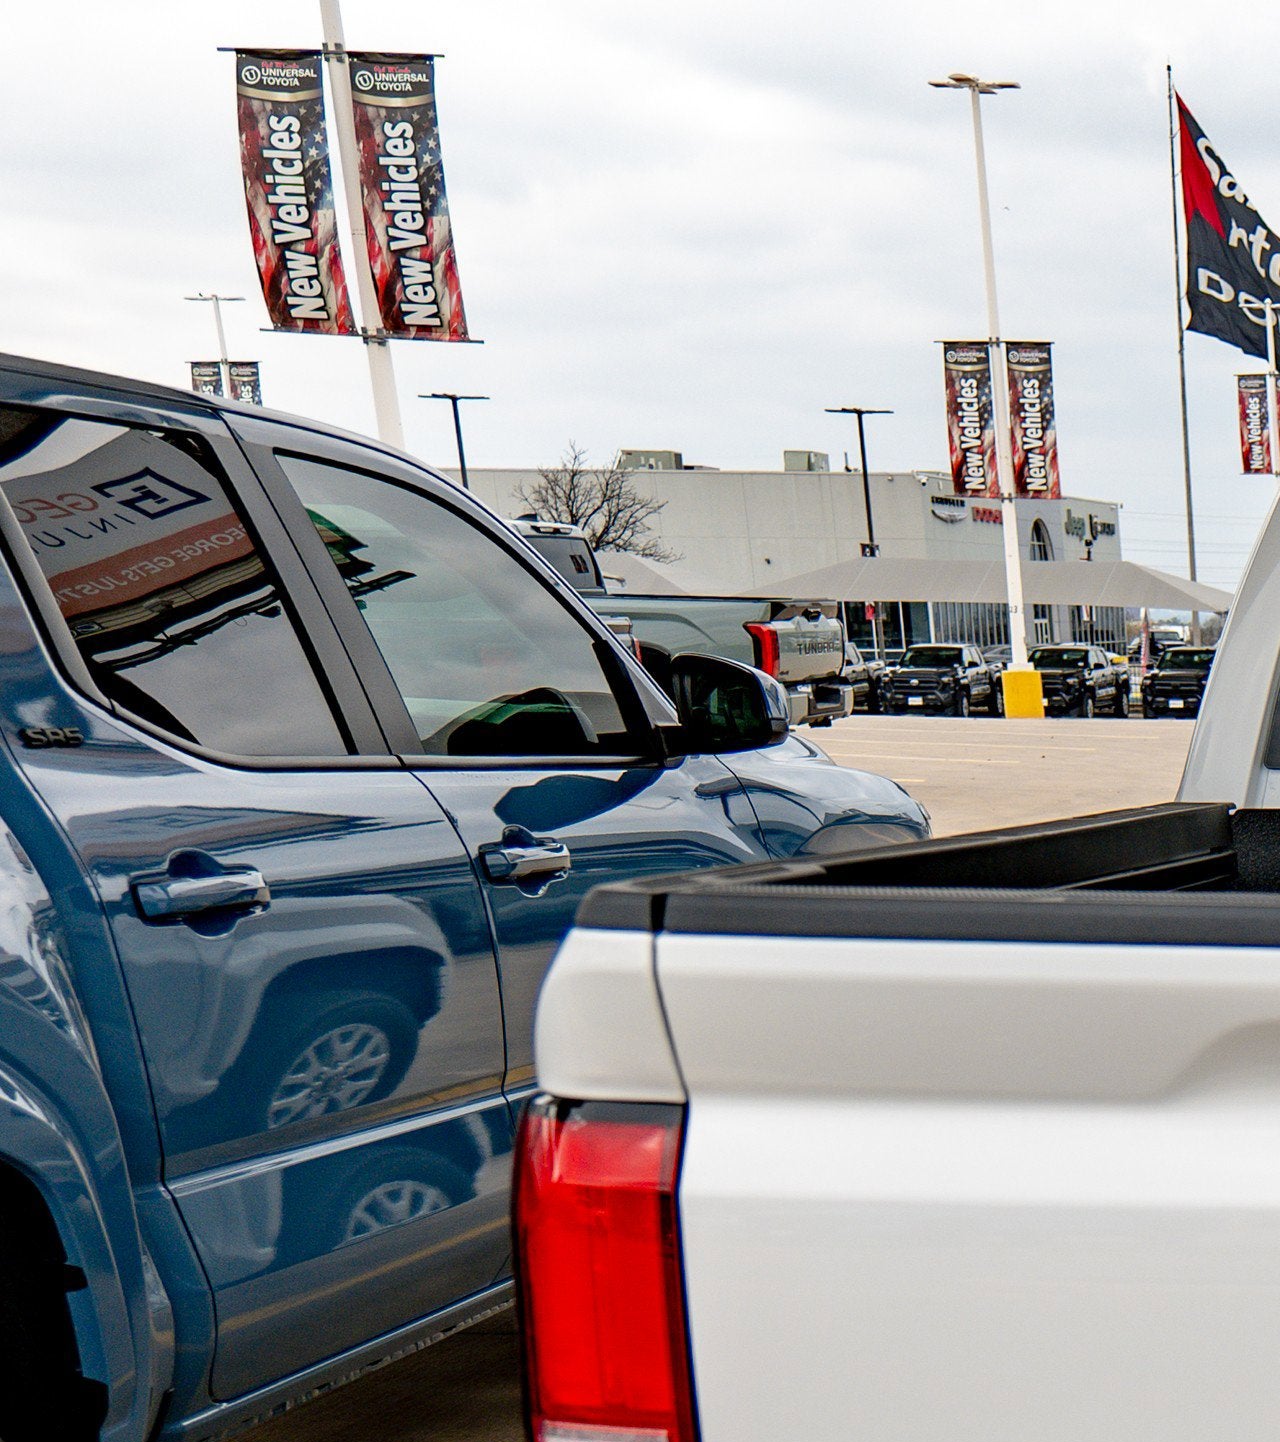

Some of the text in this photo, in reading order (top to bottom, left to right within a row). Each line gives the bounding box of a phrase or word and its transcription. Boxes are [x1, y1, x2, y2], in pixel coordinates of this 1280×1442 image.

[261, 68, 317, 78] UNIVERSAL
[261, 76, 300, 86] TOYOTA
[374, 73, 429, 83] UNIVERSAL
[374, 82, 412, 91] TOYOTA
[262, 115, 330, 320] New Vehicles
[379, 121, 443, 327] New Vehicles
[957, 378, 982, 449] Vehicles
[1019, 378, 1043, 449] Vehicles
[1246, 397, 1261, 443] Vehicles
[965, 452, 986, 490] New
[1026, 453, 1048, 491] New
[1250, 444, 1264, 469] New
[797, 640, 835, 657] TUNDRA
[25, 727, 85, 746] SR5
